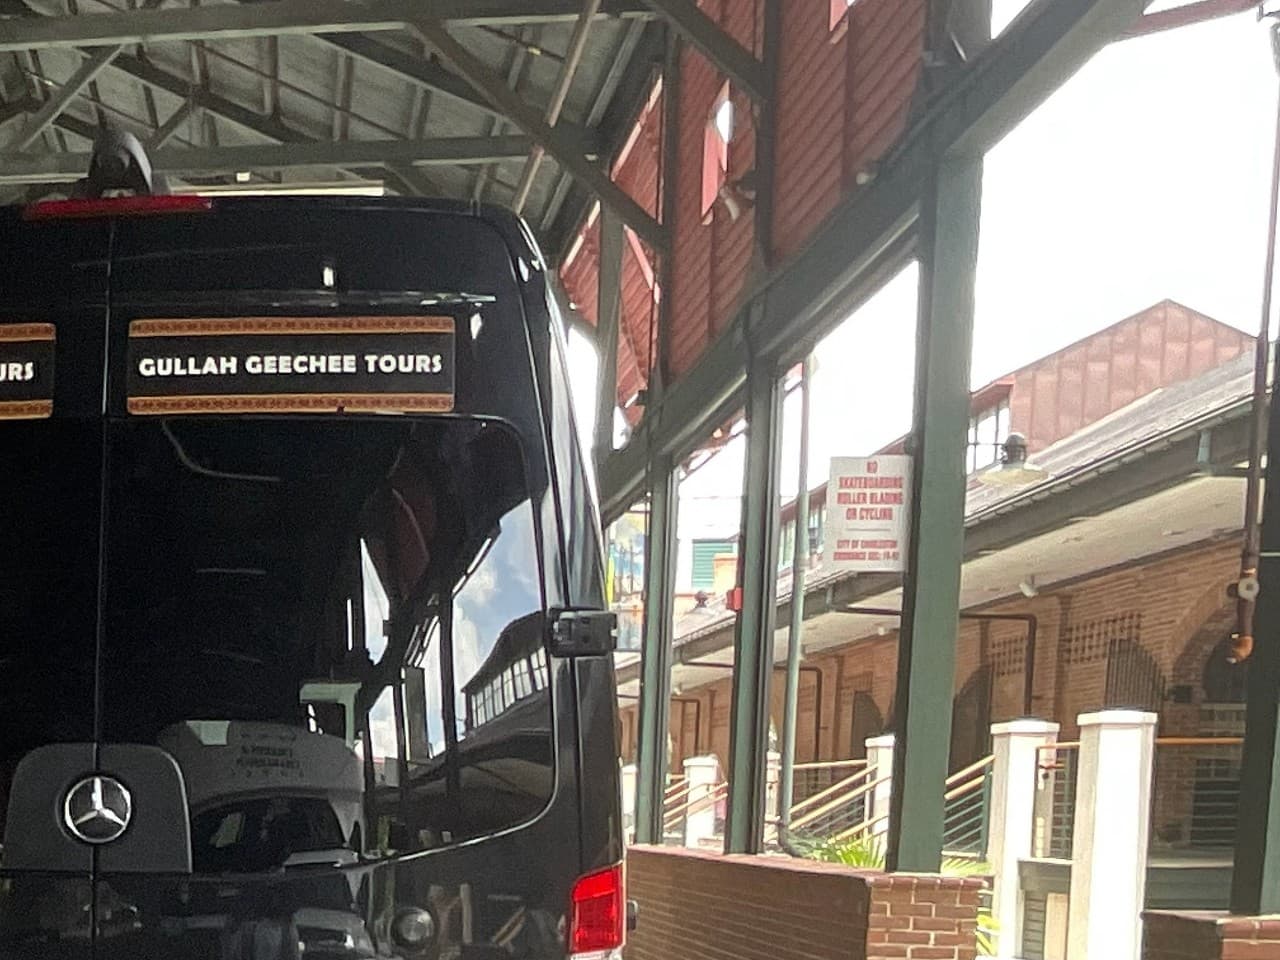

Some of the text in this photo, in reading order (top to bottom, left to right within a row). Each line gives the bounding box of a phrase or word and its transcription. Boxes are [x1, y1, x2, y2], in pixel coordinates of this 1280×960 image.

[138, 354, 442, 376] GULLAH GEECHEE TOURS
